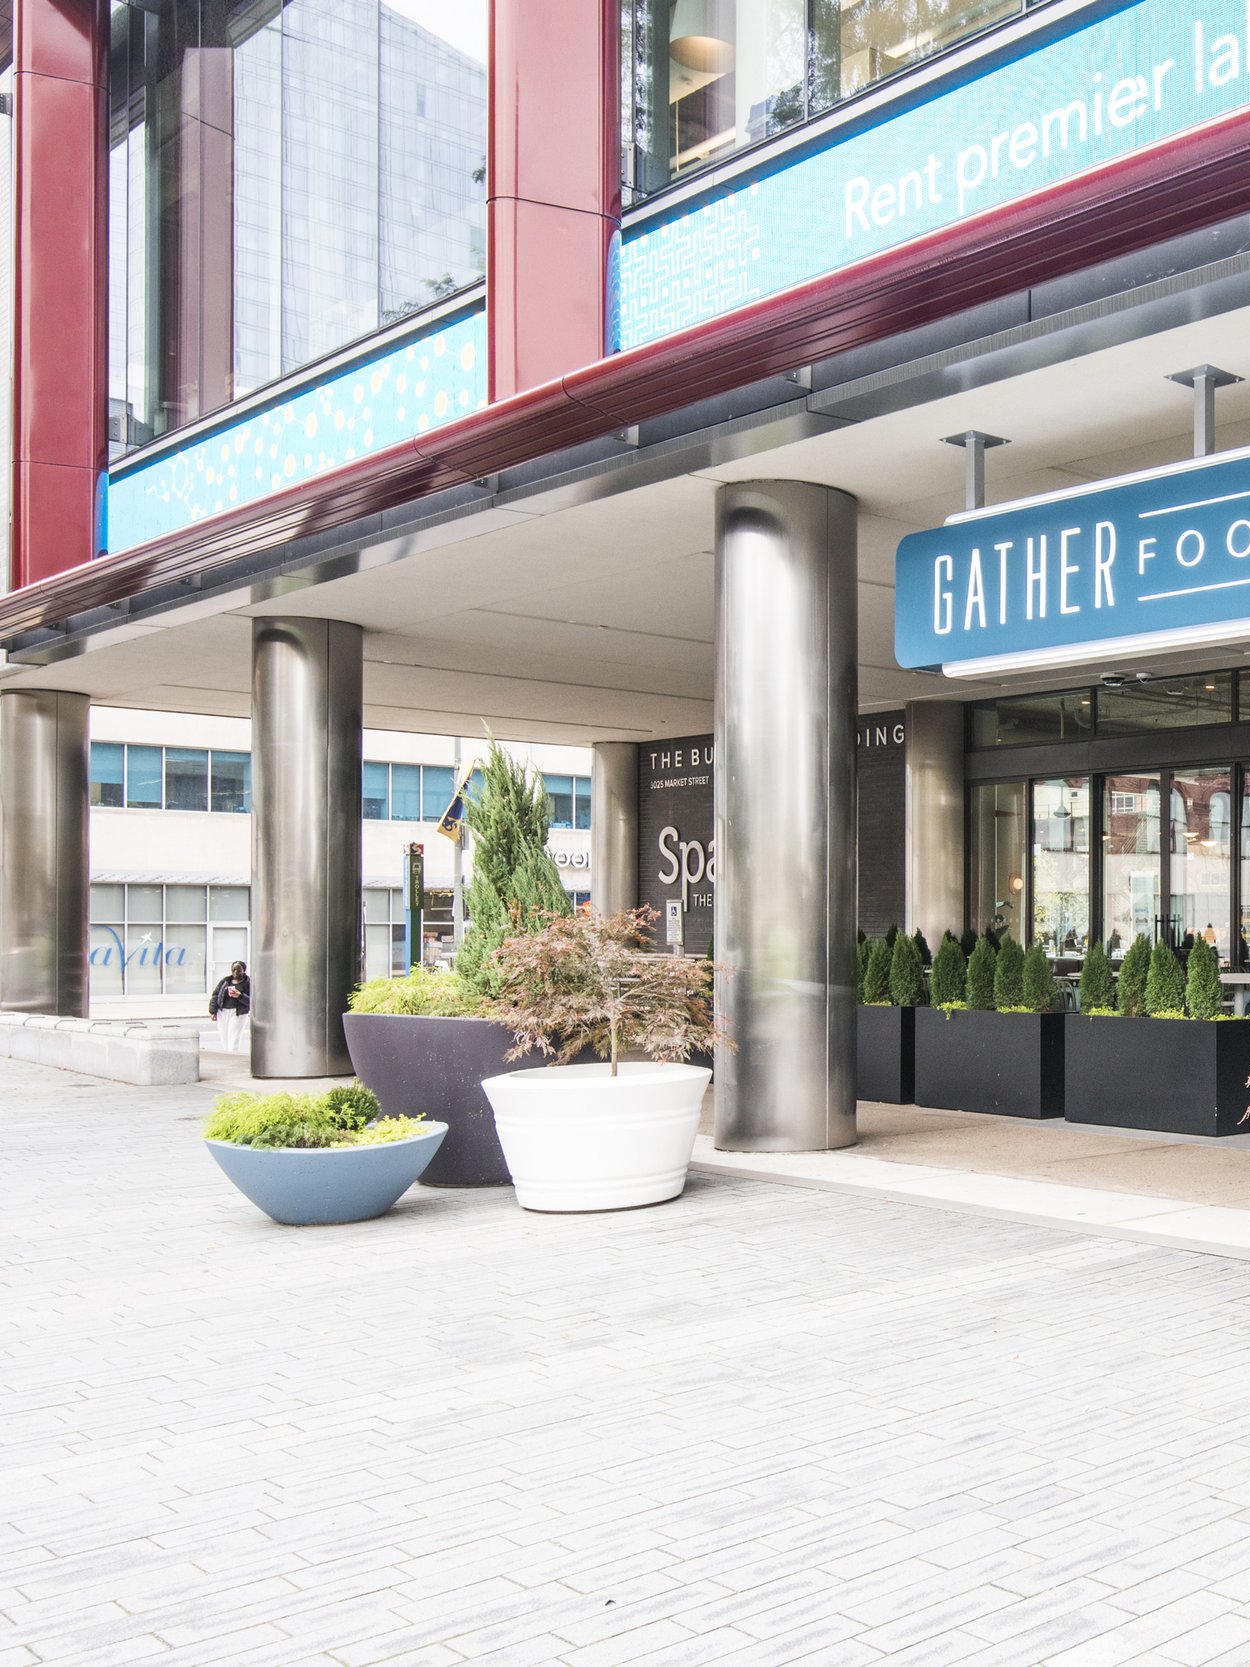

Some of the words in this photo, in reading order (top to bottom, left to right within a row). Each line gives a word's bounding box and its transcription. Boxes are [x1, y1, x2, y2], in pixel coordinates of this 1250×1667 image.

[842, 154, 941, 238] Rent
[956, 57, 1174, 214] premier
[933, 520, 1117, 635] GATHER
[650, 750, 682, 770] THE
[857, 724, 905, 747] ING
[664, 777, 687, 788] MARKET
[688, 775, 709, 786] STREET
[693, 893, 712, 907] THE
